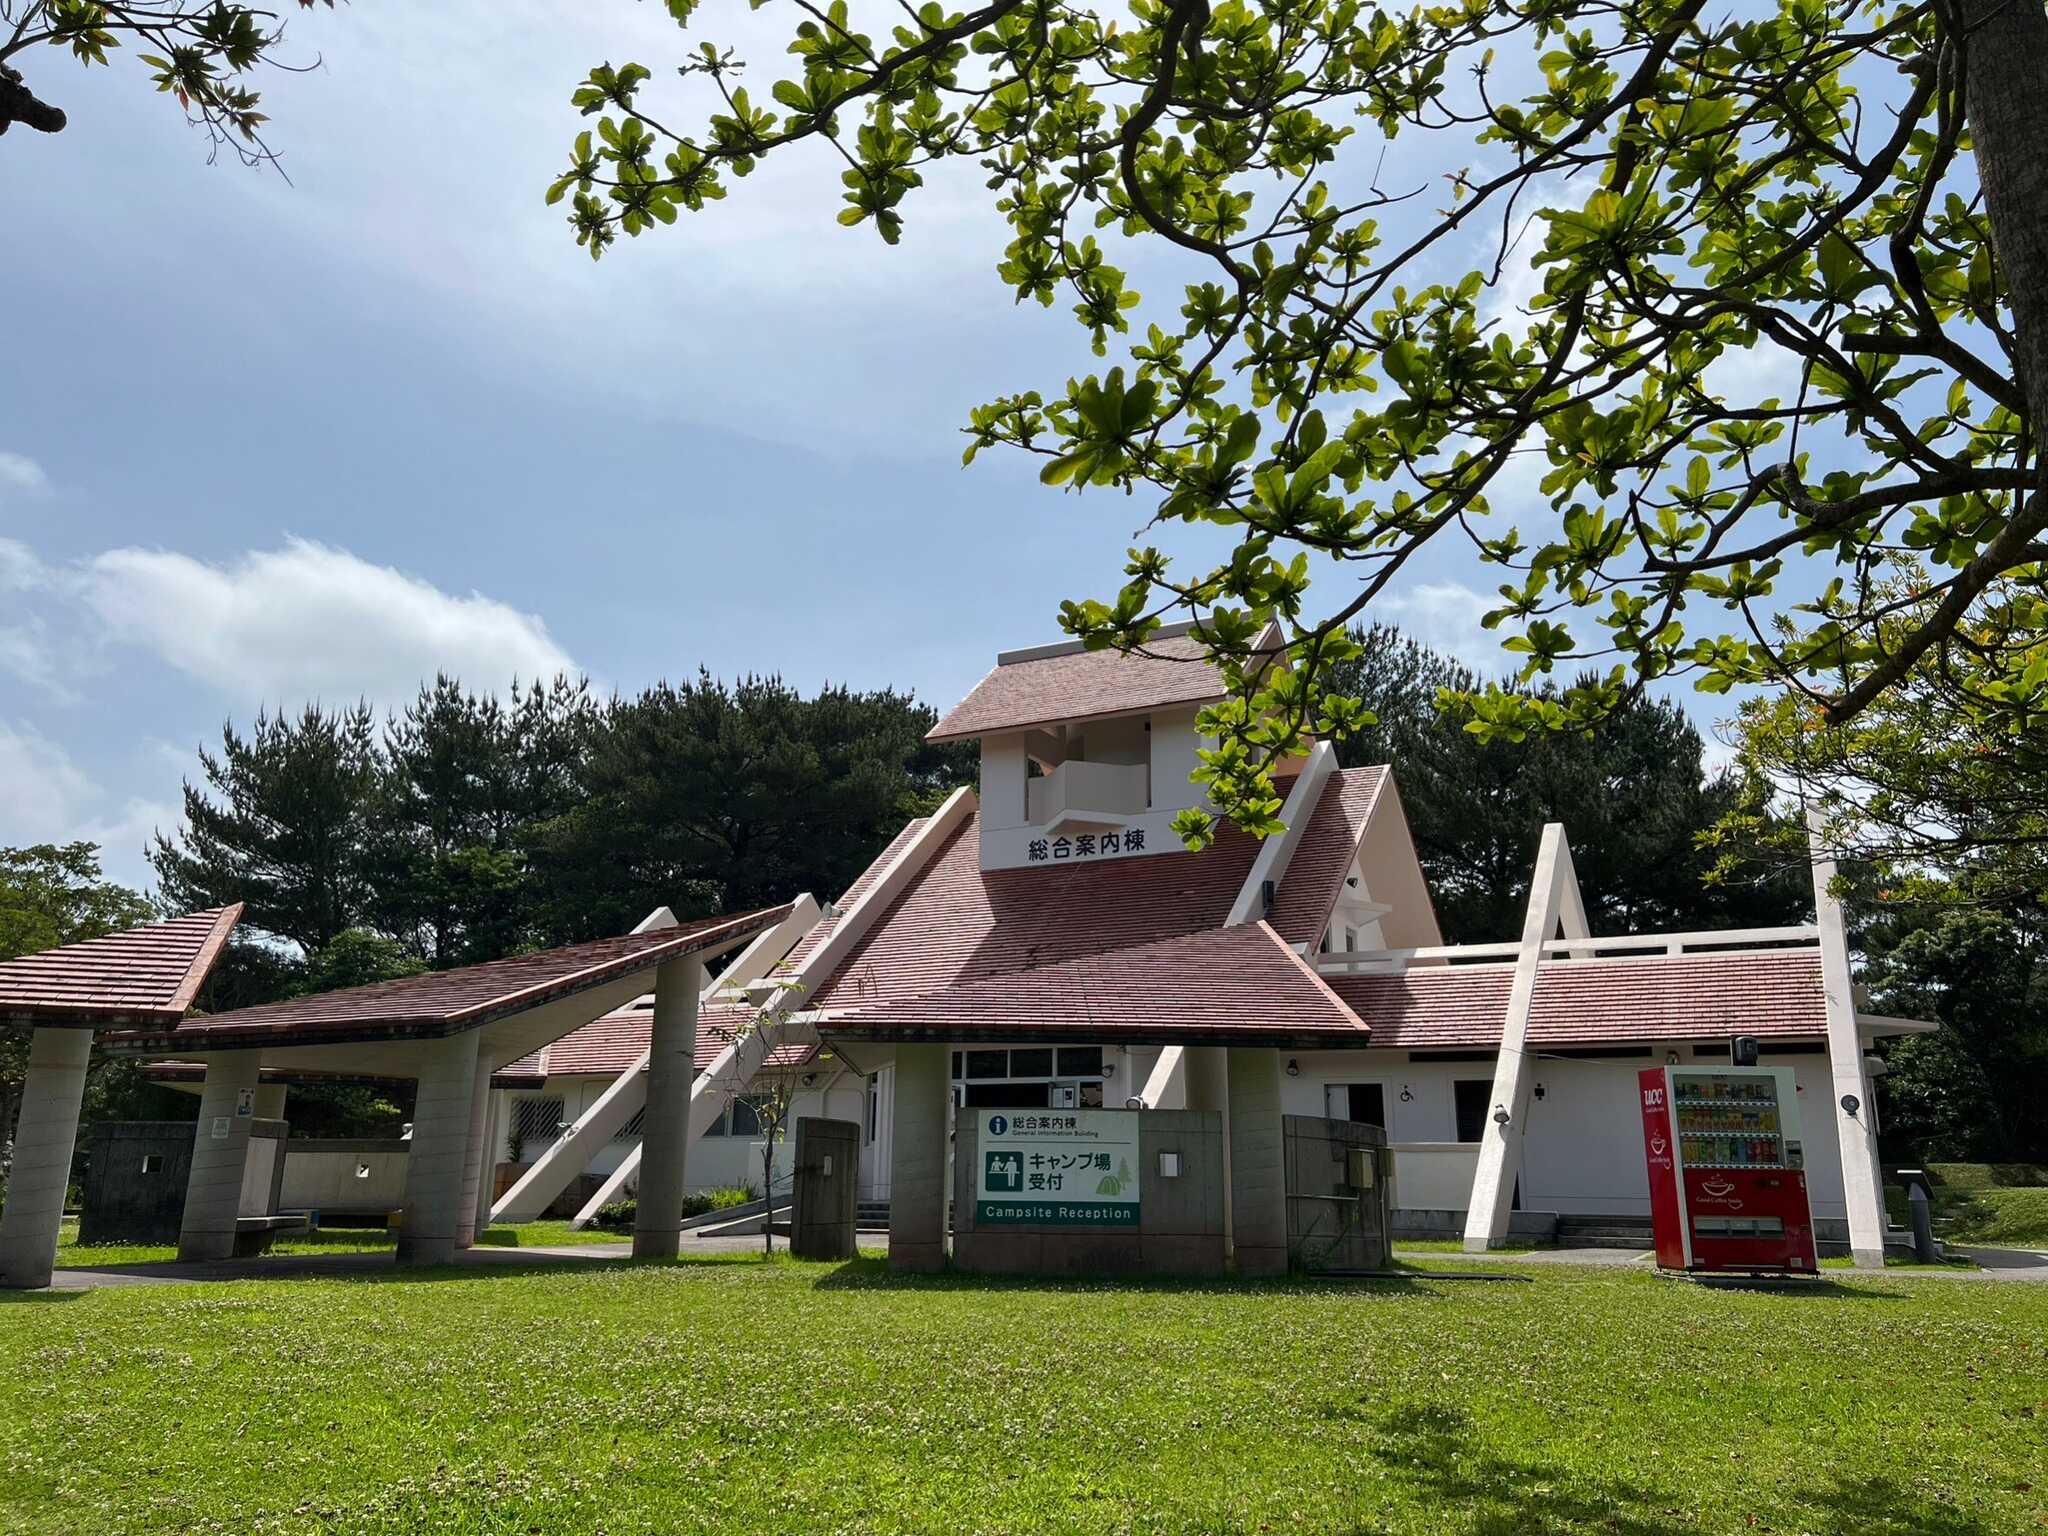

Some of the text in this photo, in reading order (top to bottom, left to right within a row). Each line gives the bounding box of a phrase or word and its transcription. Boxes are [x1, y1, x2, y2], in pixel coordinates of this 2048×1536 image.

[1029, 829, 1145, 861] 総合案内棟
[1644, 1088, 1663, 1105] UCC
[1012, 1117, 1077, 1130] 総合案内棟
[1029, 1152, 1111, 1171] キャンプ場
[1028, 1173, 1063, 1191] 受付
[986, 1206, 1131, 1219] Campsite Reception
